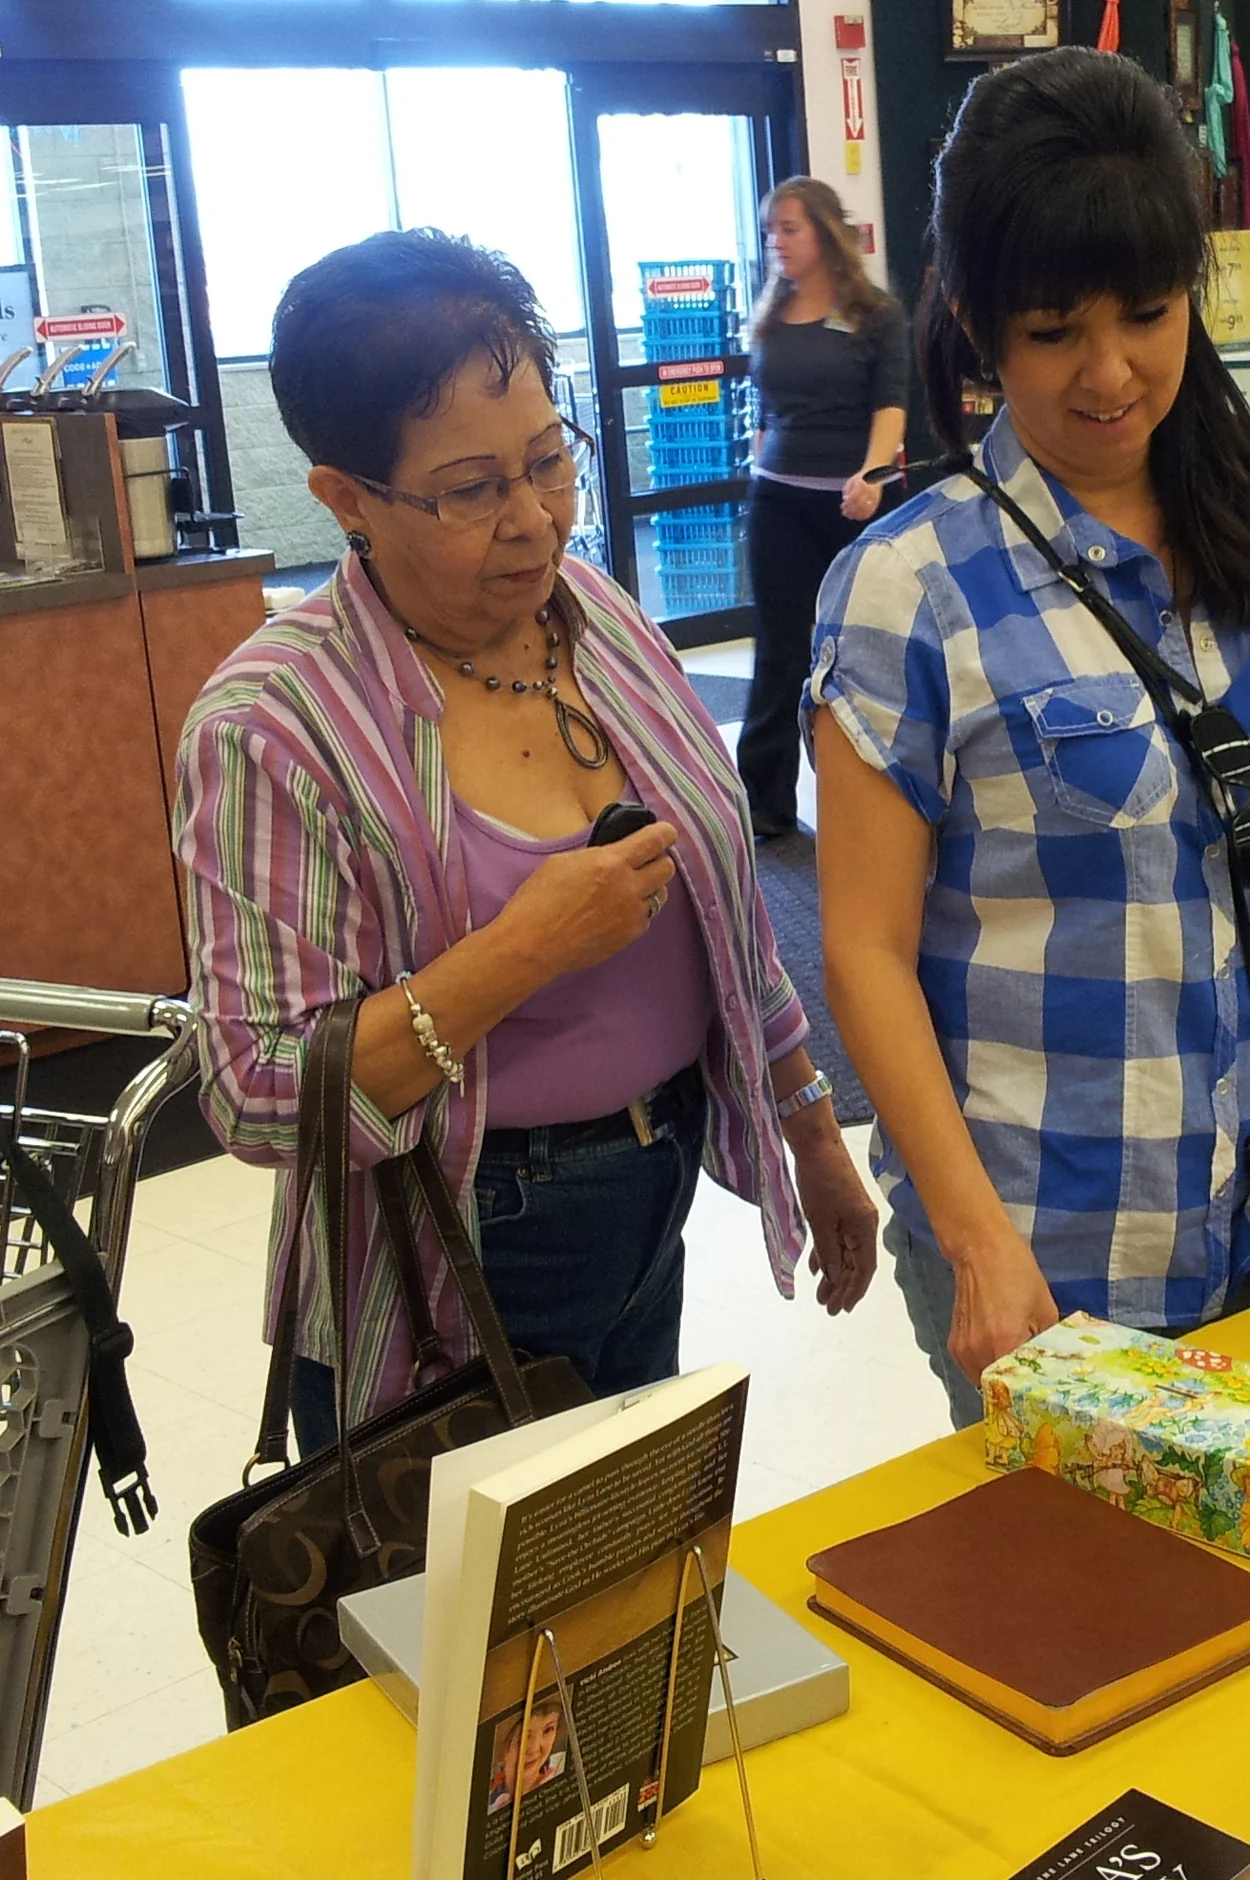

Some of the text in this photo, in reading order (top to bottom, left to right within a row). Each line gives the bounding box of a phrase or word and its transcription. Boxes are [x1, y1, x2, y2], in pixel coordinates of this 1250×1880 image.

[670, 383, 709, 395] CAUTION
[1057, 1848, 1085, 1868] LANE
[1084, 1815, 1127, 1849] TRILOGY
